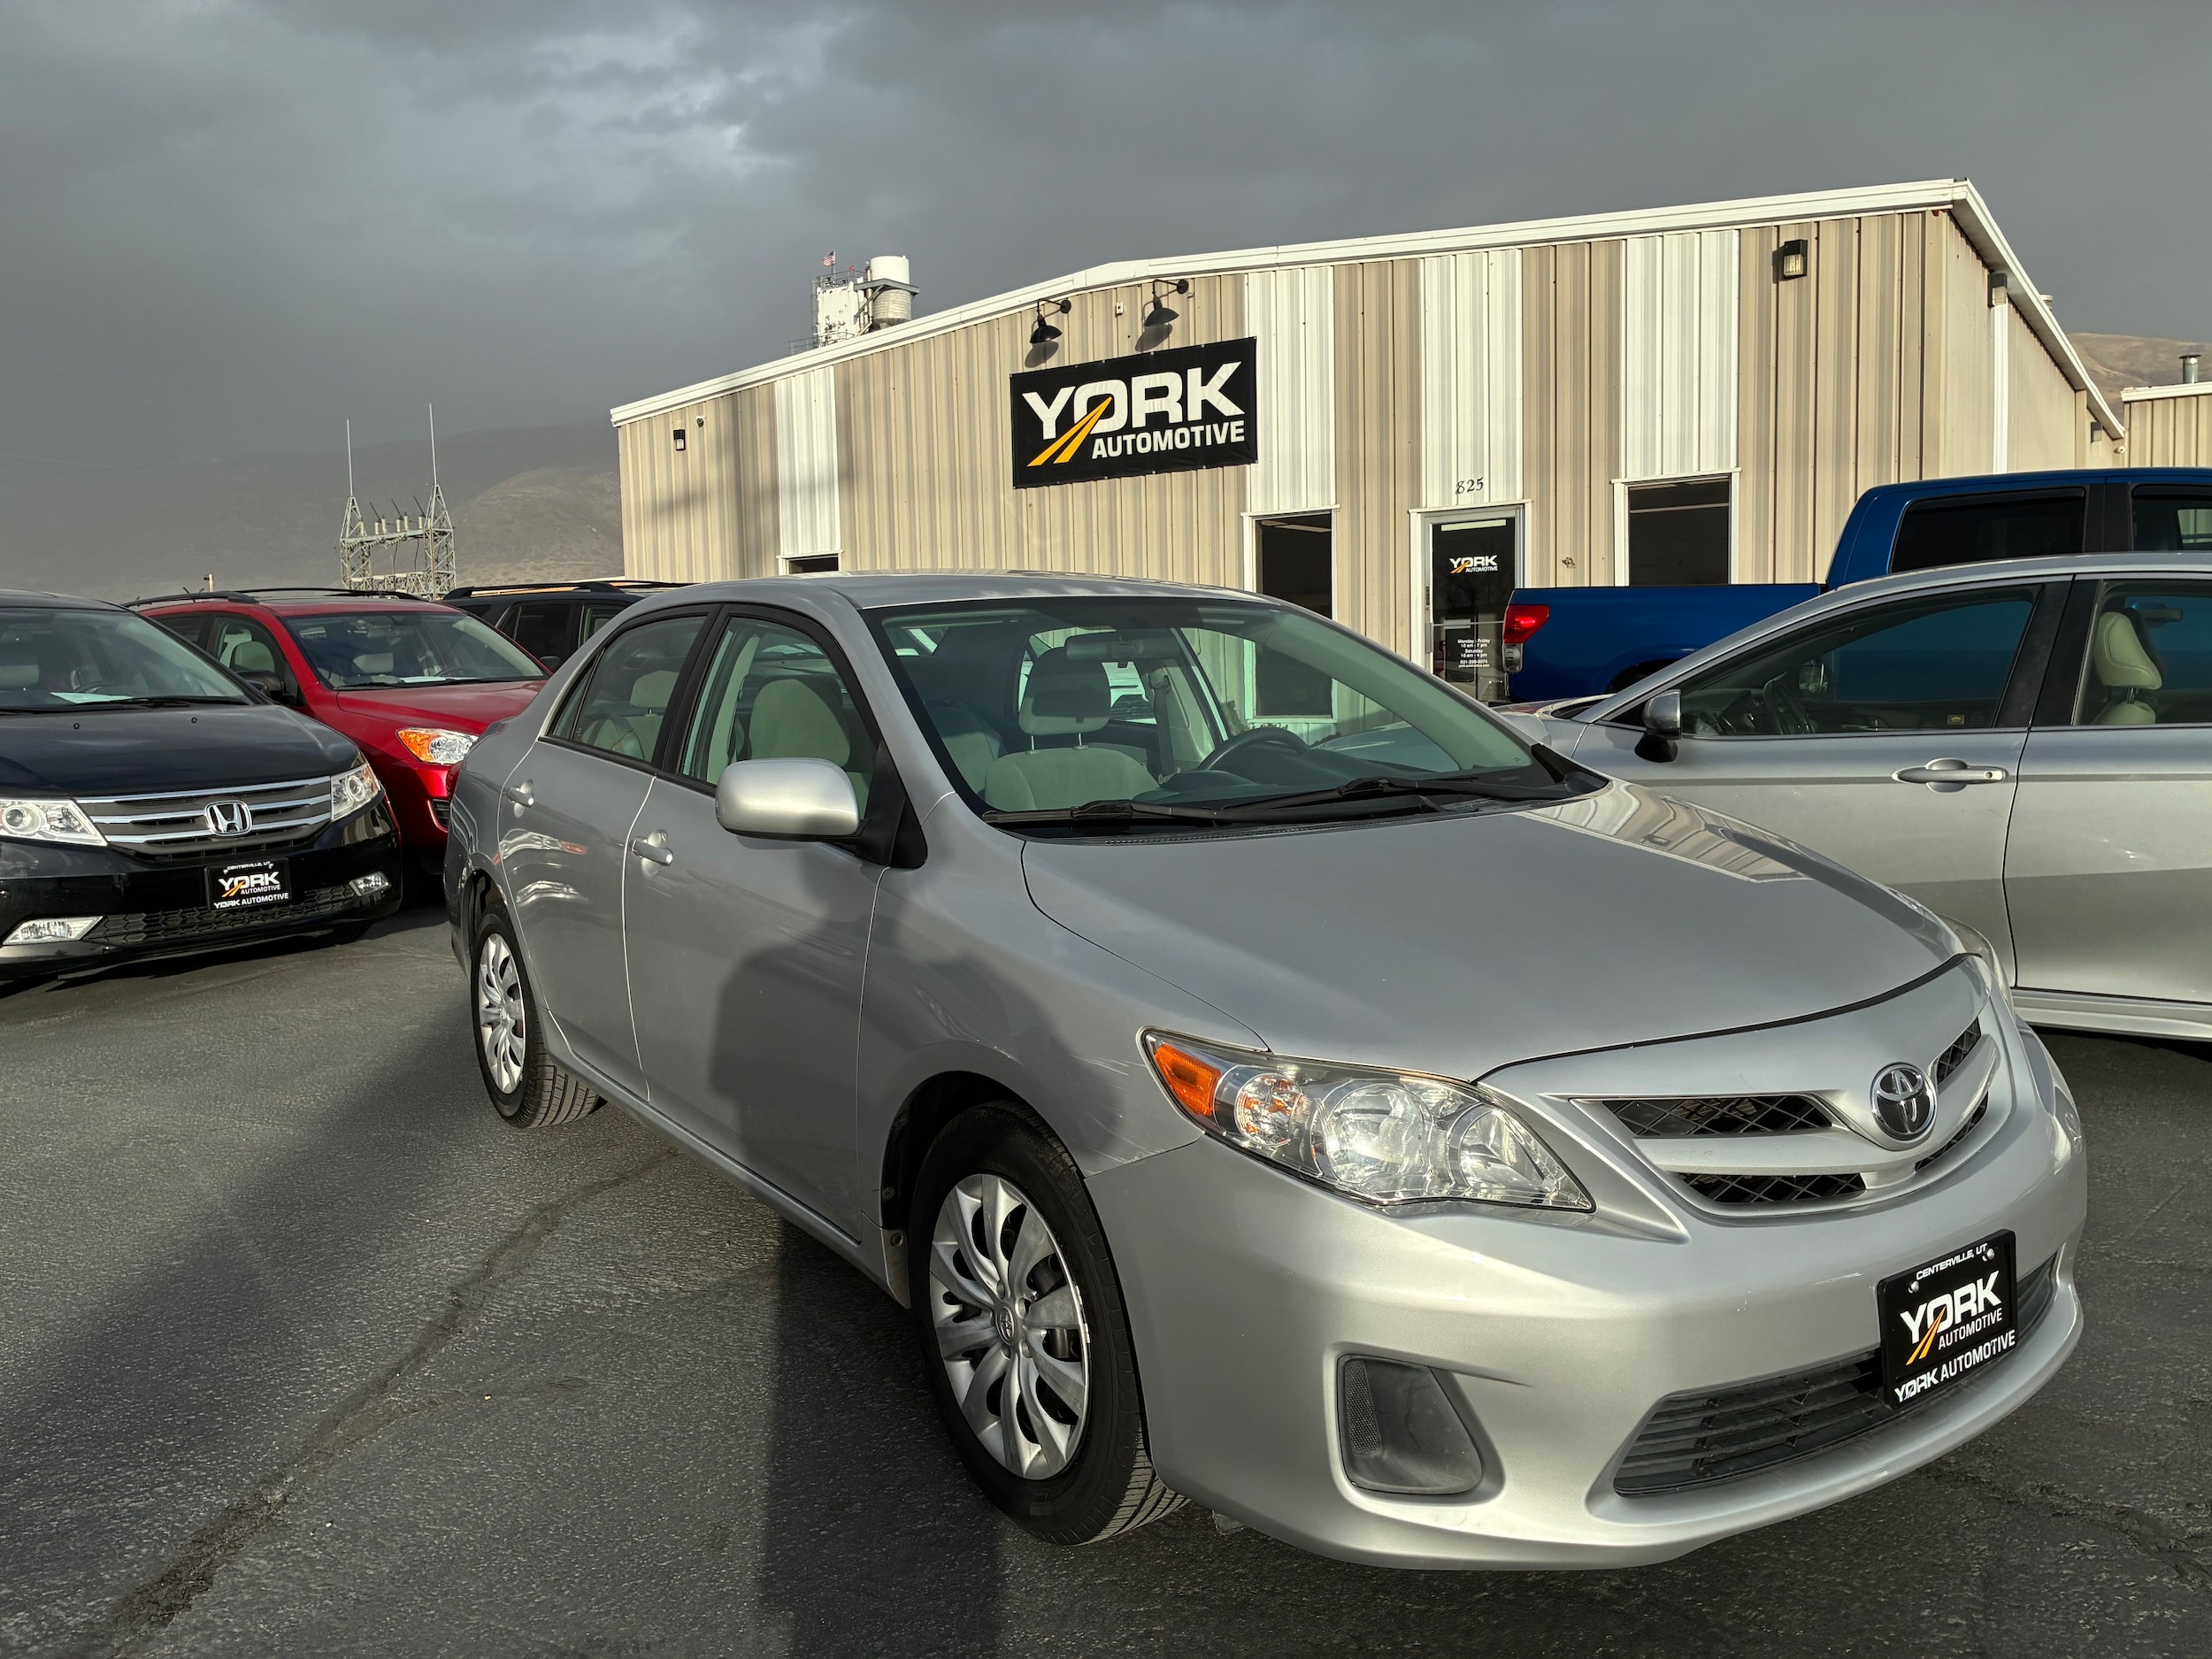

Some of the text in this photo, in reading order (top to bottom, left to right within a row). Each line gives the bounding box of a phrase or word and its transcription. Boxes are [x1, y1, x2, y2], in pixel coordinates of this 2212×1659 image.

[1021, 361, 1245, 440] YORK
[1092, 420, 1245, 459] AUTOMOTIVE
[1455, 477, 1484, 495] 825
[1449, 555, 1498, 569] YORK
[218, 872, 280, 891] YORK
[241, 885, 281, 895] AUTOMOTIVE
[213, 892, 289, 910] YORK AUTOMOTIVE
[1916, 1242, 1988, 1280] CENTERVILLE, UT
[1900, 1271, 2001, 1344] YORK
[1938, 1307, 2002, 1350] AUTOMOTIVE
[1894, 1329, 2016, 1402] YORK AUTOMOTIVE
